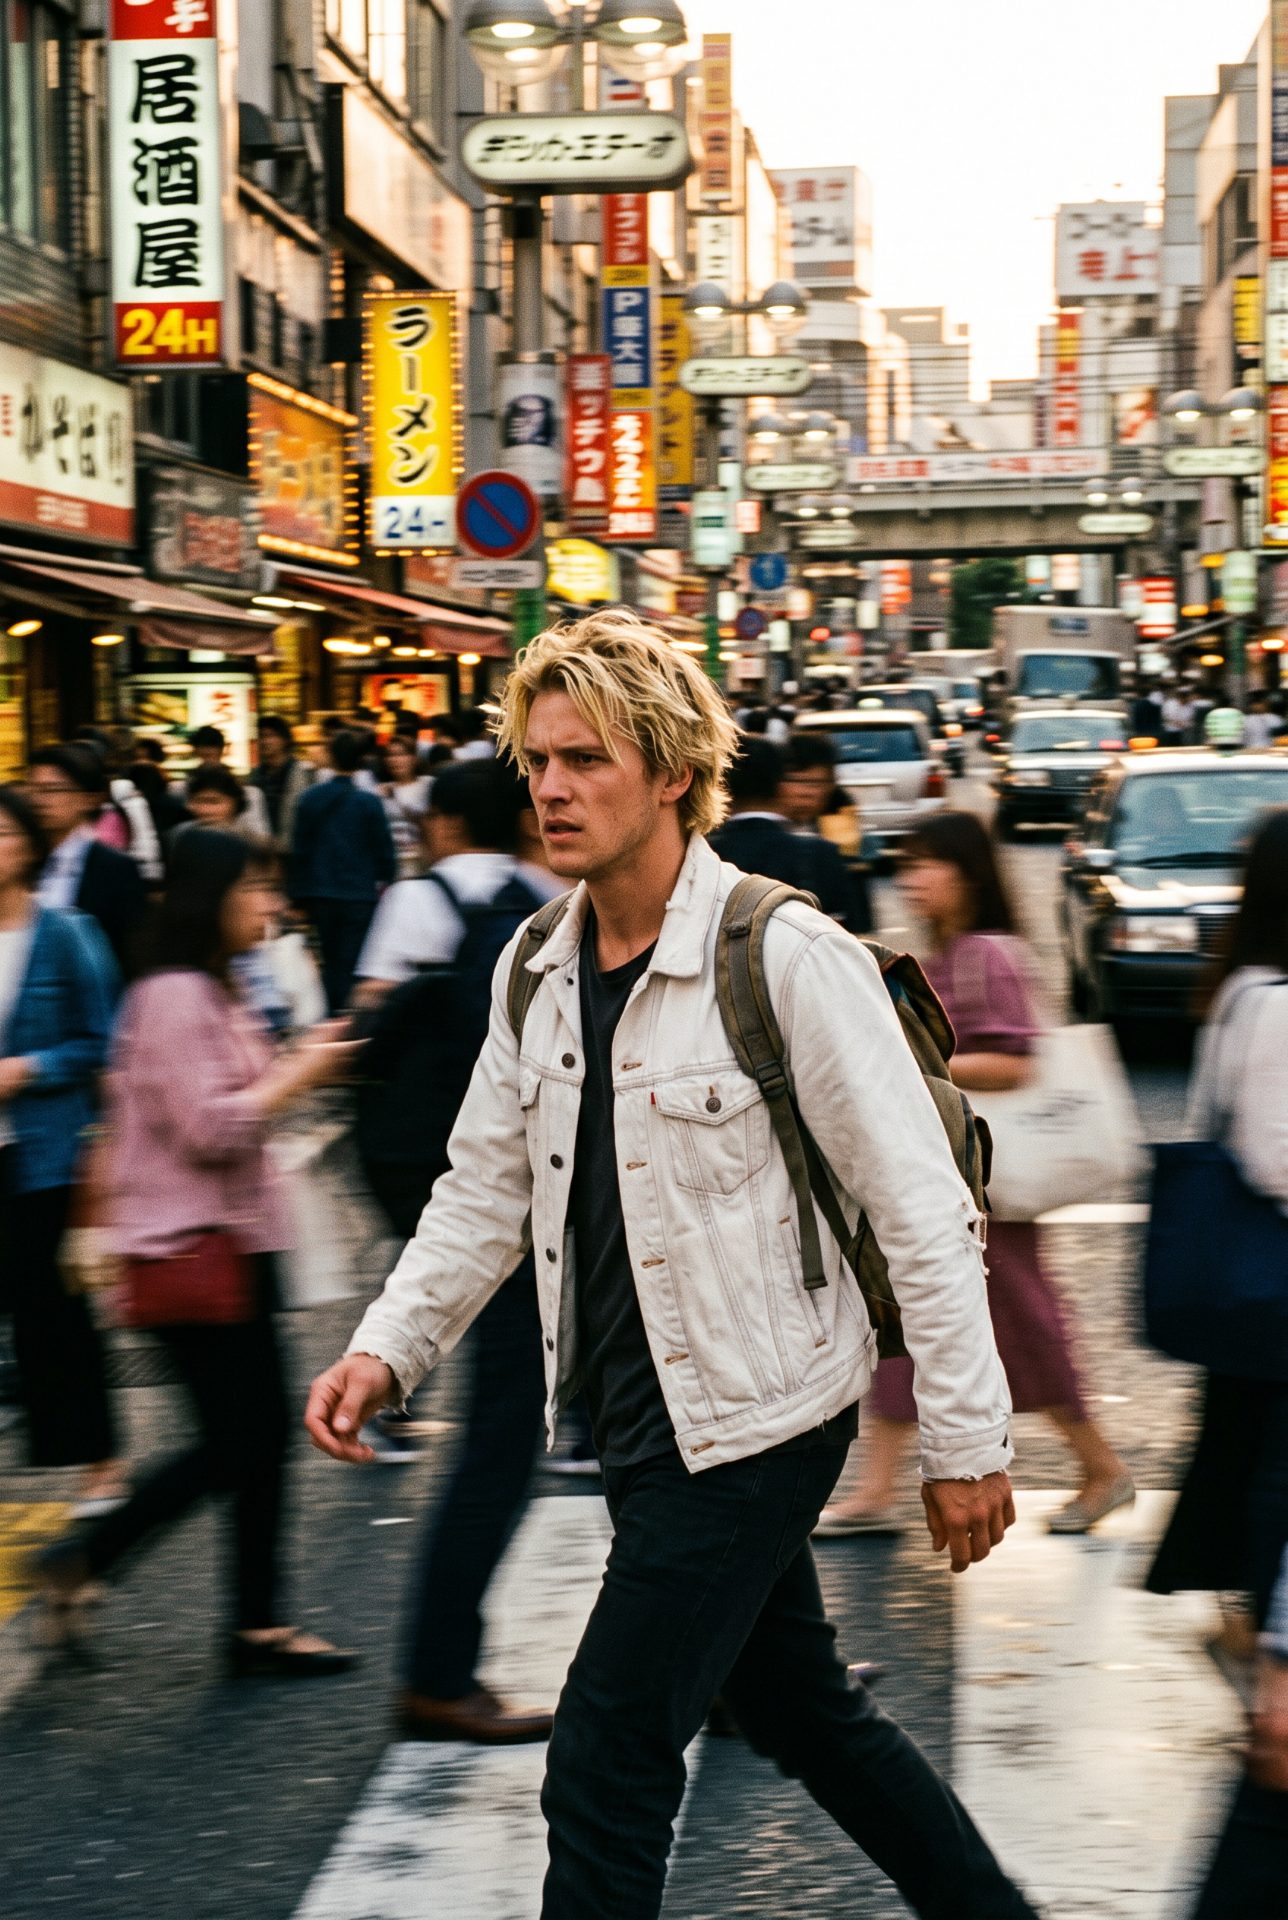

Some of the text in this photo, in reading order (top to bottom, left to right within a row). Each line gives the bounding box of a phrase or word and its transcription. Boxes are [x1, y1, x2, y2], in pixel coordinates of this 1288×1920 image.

[131, 54, 201, 288] 居酒屋
[122, 308, 217, 355] 24H
[387, 304, 438, 487] ラーメン
